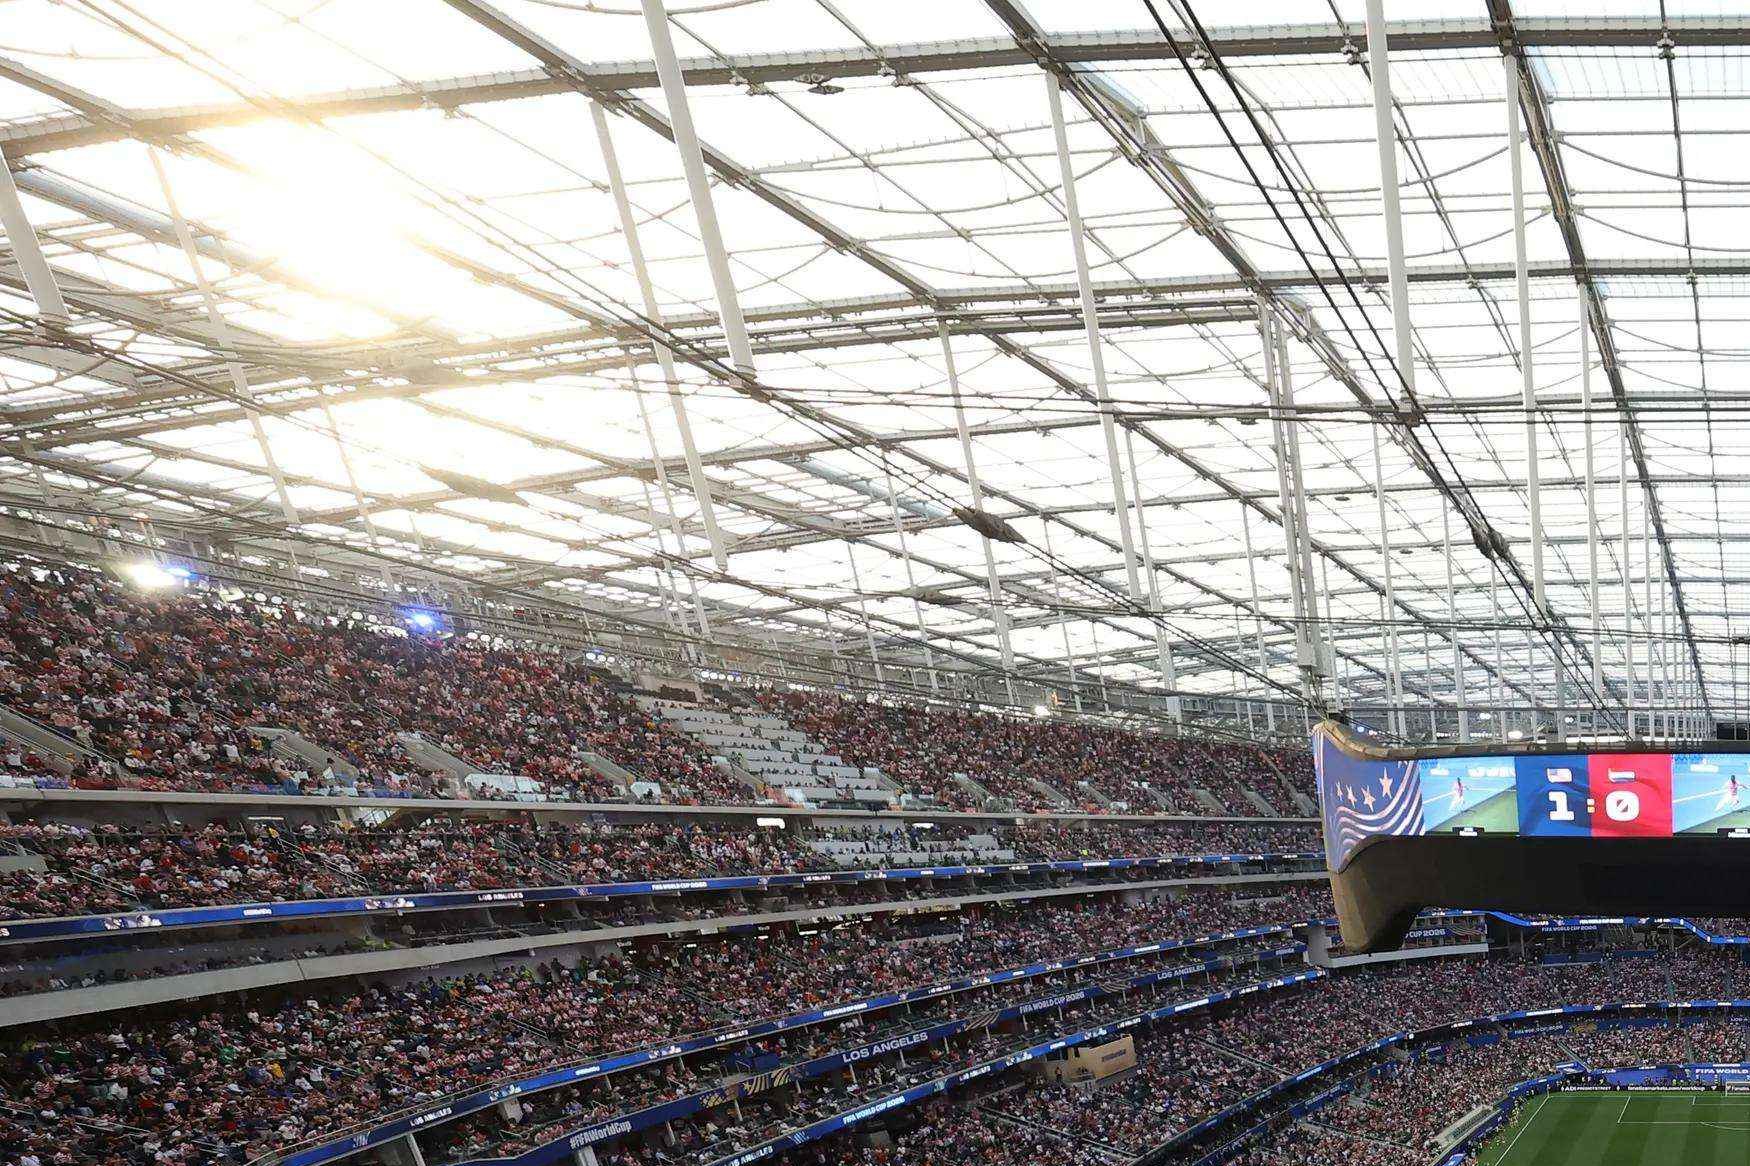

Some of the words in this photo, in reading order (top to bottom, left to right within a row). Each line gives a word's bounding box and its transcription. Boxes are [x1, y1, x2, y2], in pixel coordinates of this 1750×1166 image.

[1549, 791, 1574, 821] 1
[1605, 790, 1640, 822] 0
[1409, 930, 1422, 938] CUP
[1157, 971, 1172, 981] LOS
[842, 1048, 870, 1064] LOS
[871, 1031, 929, 1057] ANGELES
[842, 1111, 856, 1126] FIFA
[856, 1105, 877, 1121] WORLD
[876, 1102, 888, 1115] CUP
[569, 1120, 632, 1150] #FIFAWorldCup
